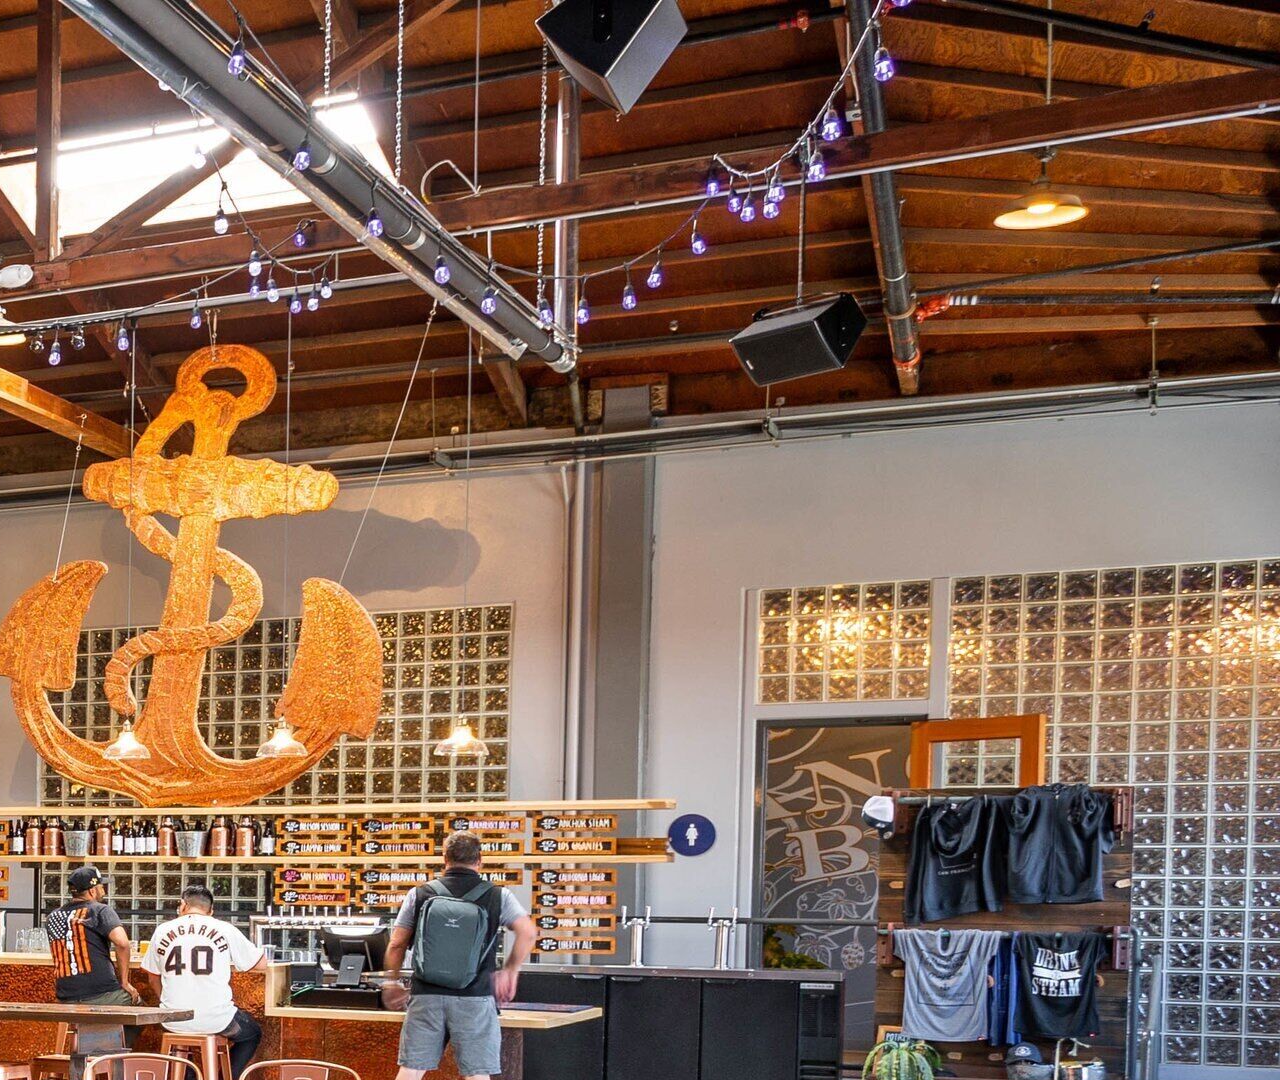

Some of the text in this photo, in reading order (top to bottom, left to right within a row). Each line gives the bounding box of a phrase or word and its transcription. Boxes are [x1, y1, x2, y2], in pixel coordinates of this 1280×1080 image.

[558, 819, 610, 828] ANCHOR STEAM
[157, 924, 229, 956] BUMGARNER
[164, 945, 214, 976] 40
[1033, 947, 1081, 971] DRINK
[1032, 977, 1081, 997] STEAM
